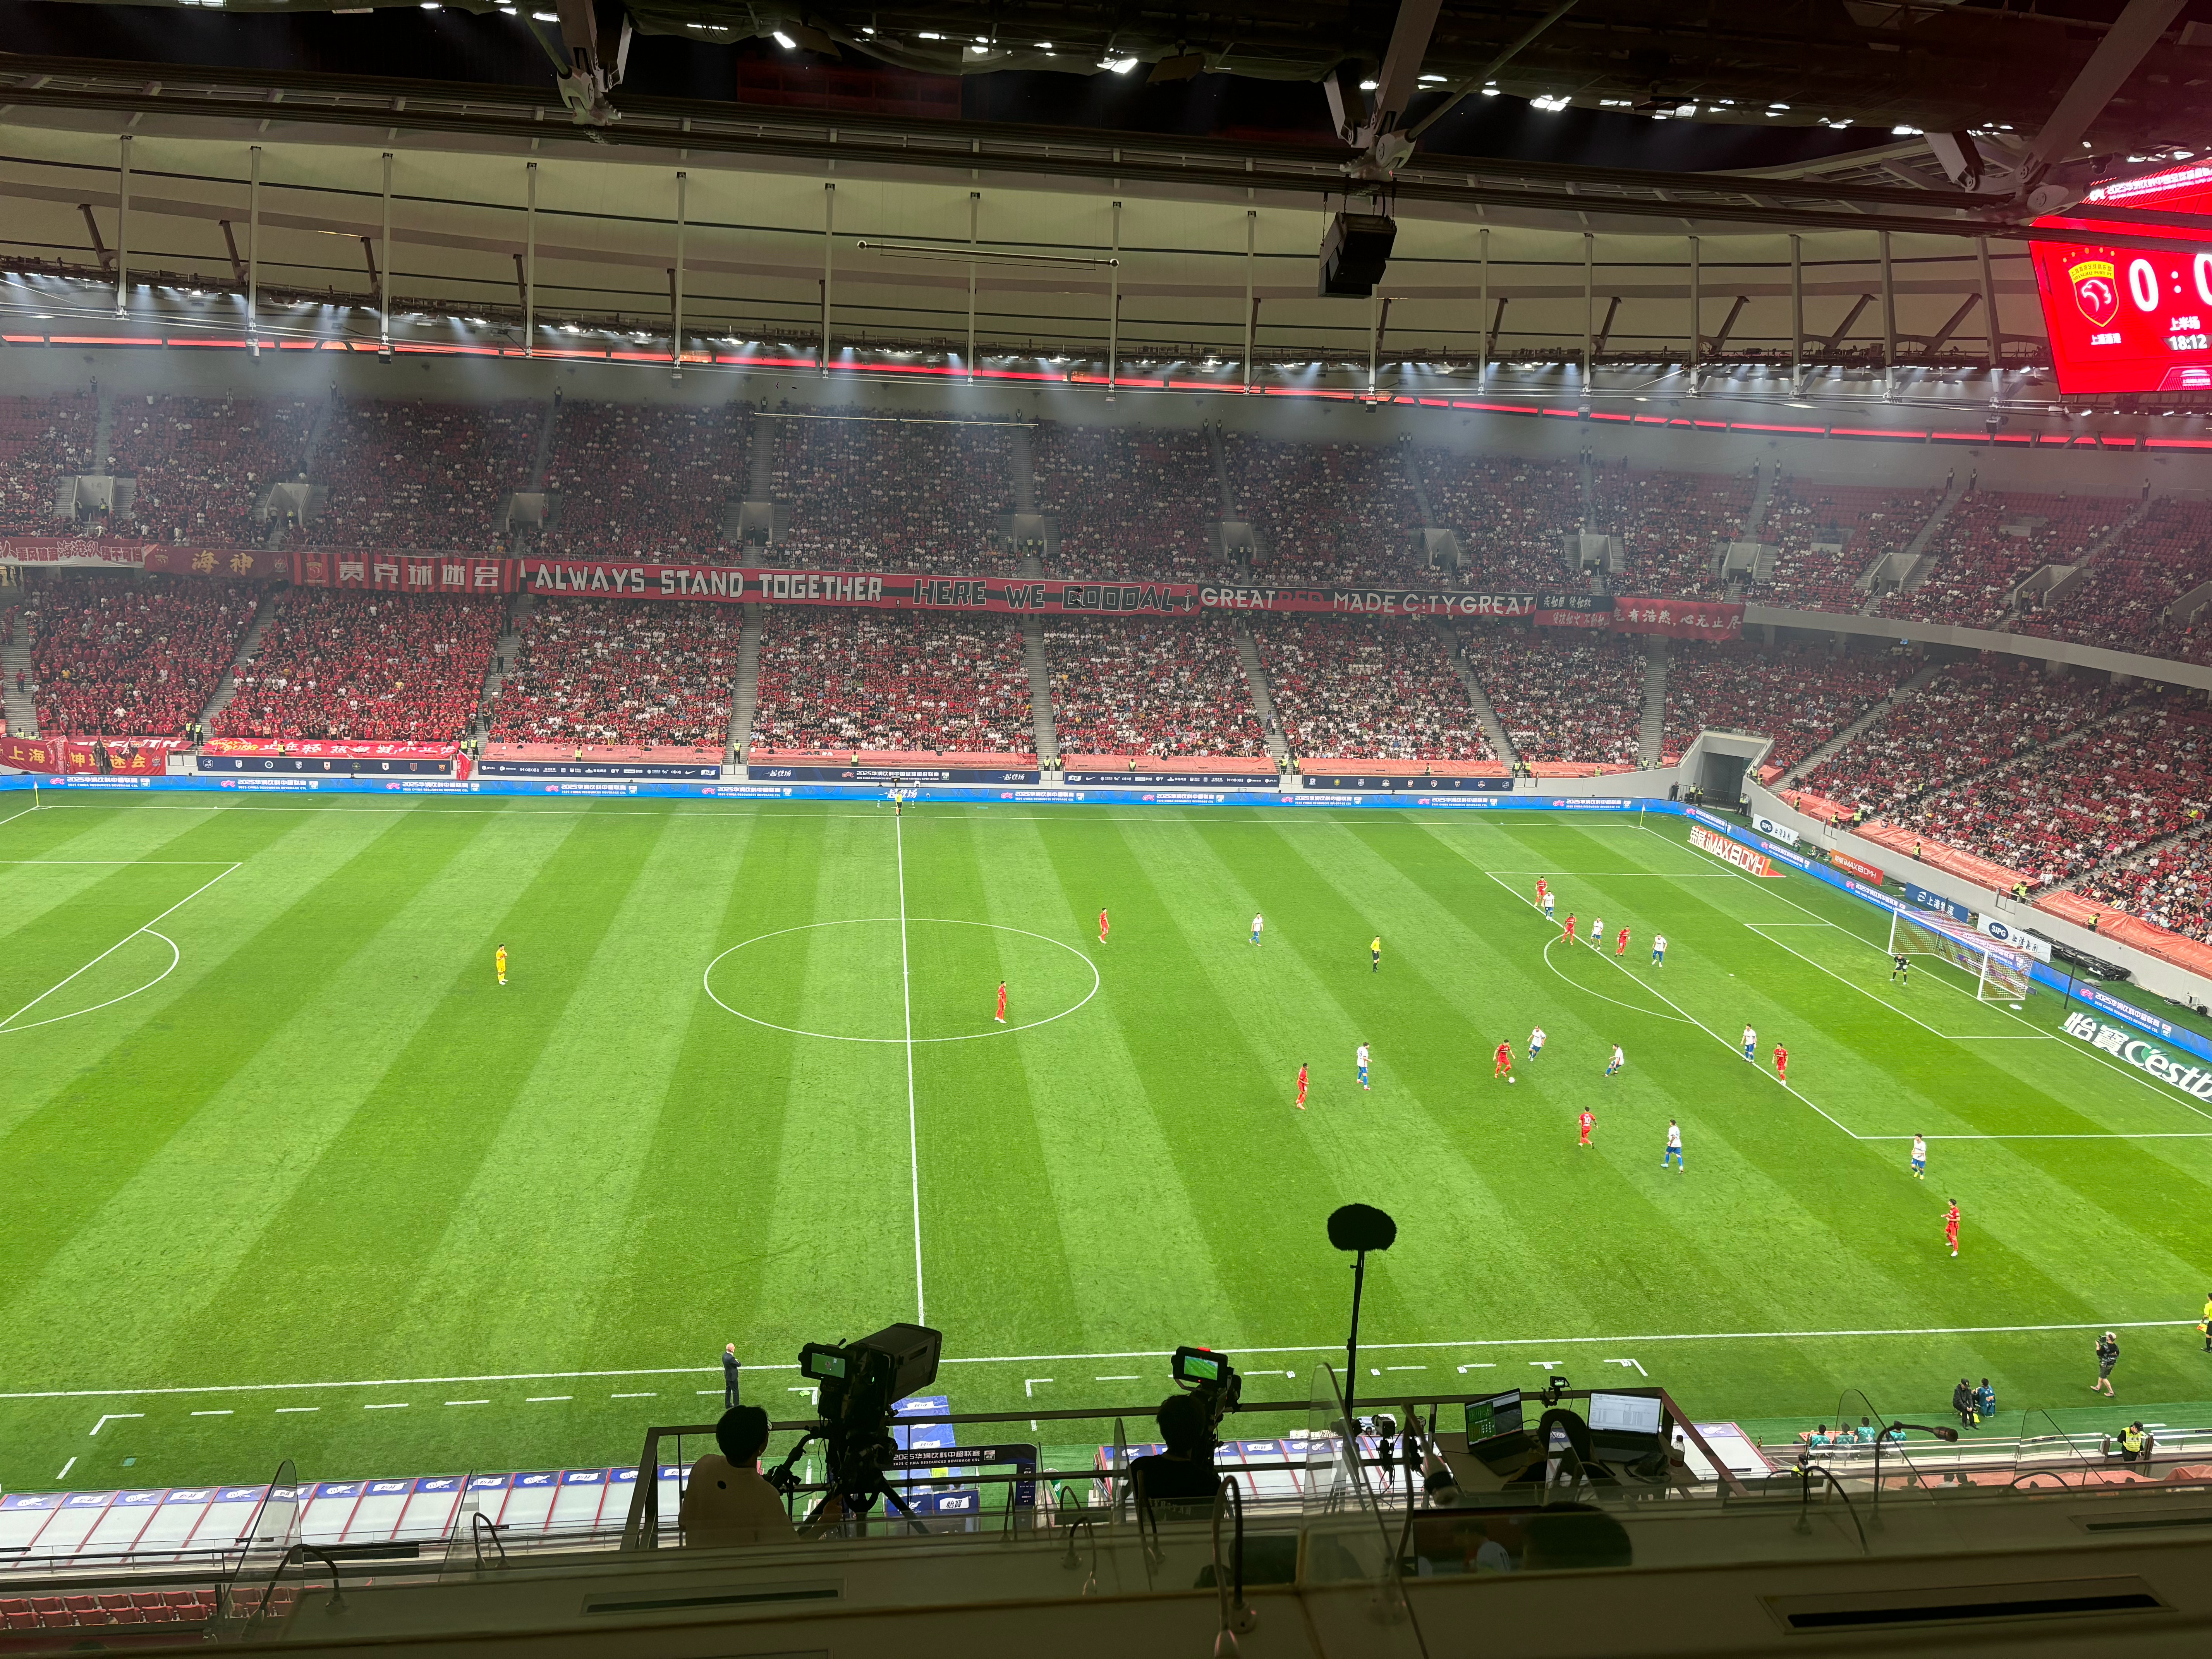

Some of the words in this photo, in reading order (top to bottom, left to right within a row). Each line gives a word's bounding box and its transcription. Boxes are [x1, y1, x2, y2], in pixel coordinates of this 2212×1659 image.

[2130, 259, 2159, 311] 0
[2169, 316, 2201, 331] 上半场
[2170, 334, 2207, 350] 18:12
[535, 563, 645, 593] ALWAYS
[661, 569, 744, 598] STAND
[913, 579, 987, 606] HERE
[1005, 583, 1045, 610] WE
[1200, 587, 1276, 609] GREAT
[1334, 591, 1395, 613] MADE
[1459, 594, 1535, 616] GREAT
[1762, 822, 1771, 831] SIPG
[1991, 925, 2006, 937] SIPG
[946, 1500, 962, 1508] 怡寶
